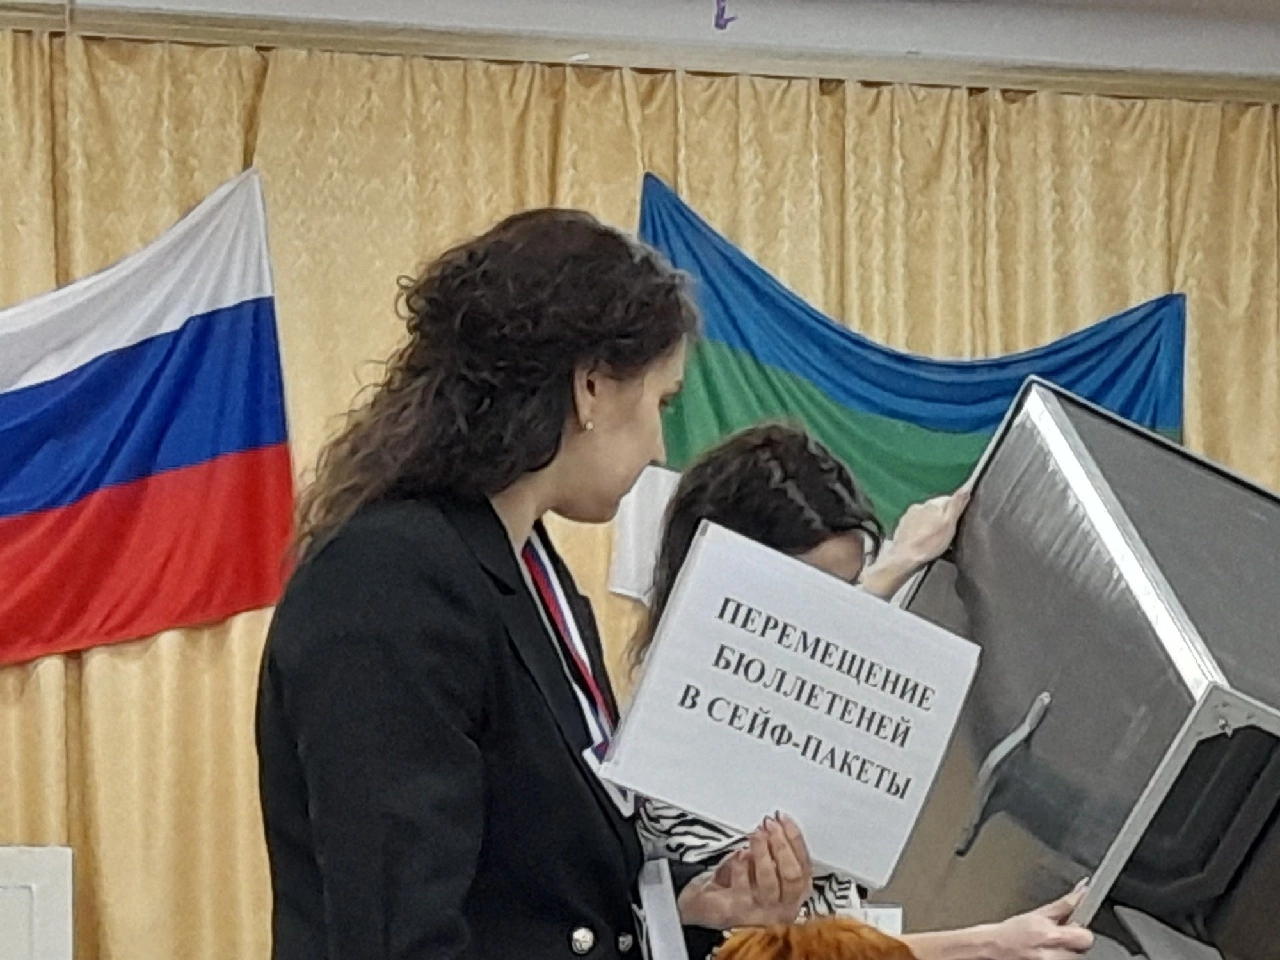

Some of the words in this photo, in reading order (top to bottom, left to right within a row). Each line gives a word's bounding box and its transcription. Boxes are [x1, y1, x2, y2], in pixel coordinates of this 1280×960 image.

[712, 643, 911, 748] БЮЛЛЕТЕНЕЙ
[715, 597, 936, 712] ПЕРЕМЕЩЕНИЕ
[678, 684, 701, 710] В
[707, 696, 912, 800] СЕЙФ-ПАКЕТЫ
